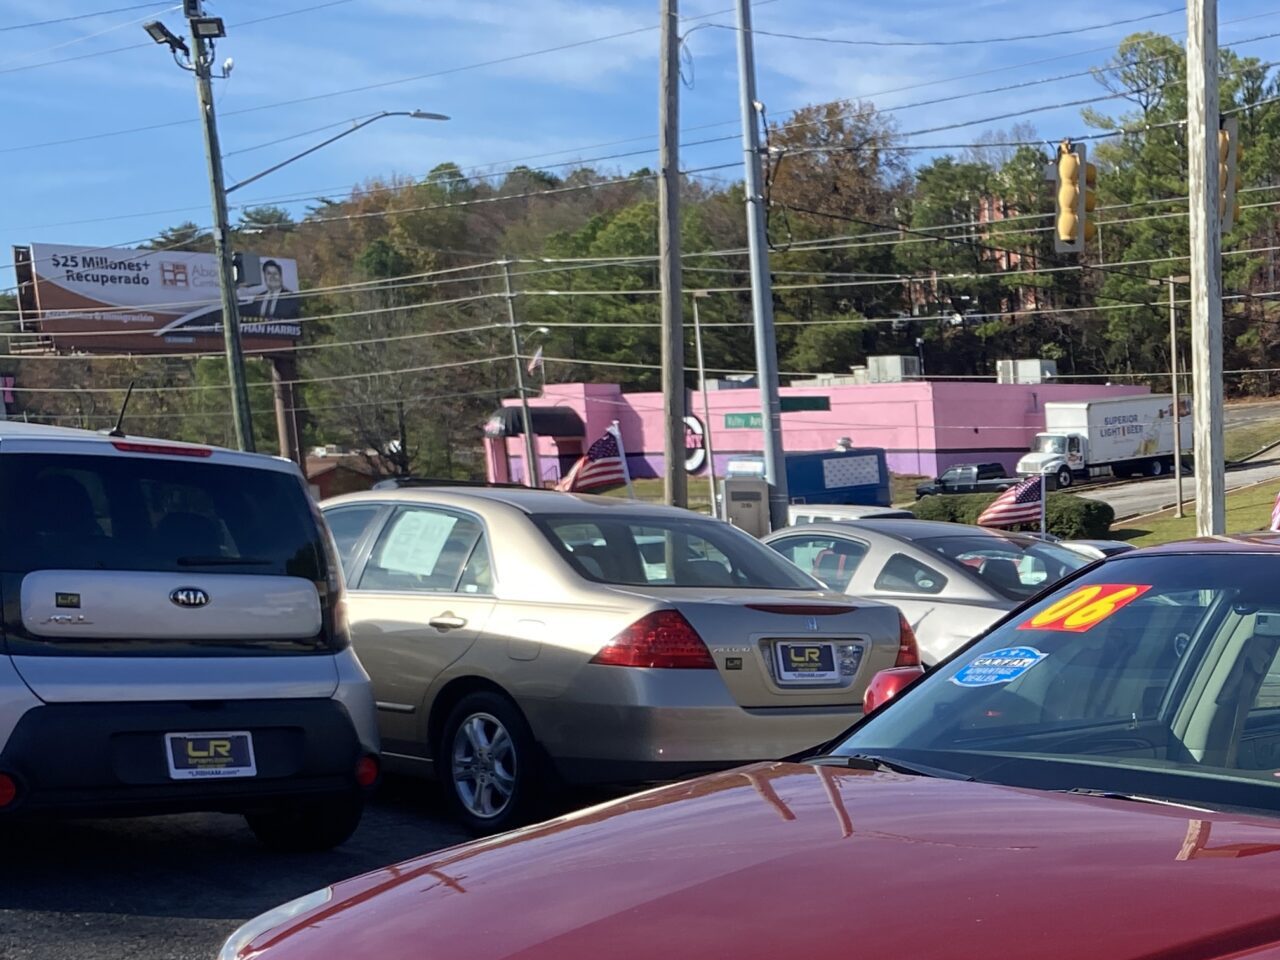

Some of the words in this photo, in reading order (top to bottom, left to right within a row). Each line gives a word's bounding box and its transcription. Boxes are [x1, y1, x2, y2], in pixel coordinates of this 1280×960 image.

[51, 254, 79, 268] $25
[81, 255, 151, 272] Millones+
[65, 269, 150, 287] Recuperado
[266, 324, 302, 337] HARRIS
[1103, 414, 1138, 426] SUPERIOR
[1100, 426, 1121, 438] LIGHT
[1126, 424, 1144, 435] BEER
[177, 590, 206, 604] KIA
[1030, 585, 1138, 629] 06
[790, 648, 820, 662] LR
[962, 674, 999, 682] DEALER
[187, 740, 231, 757] LR
